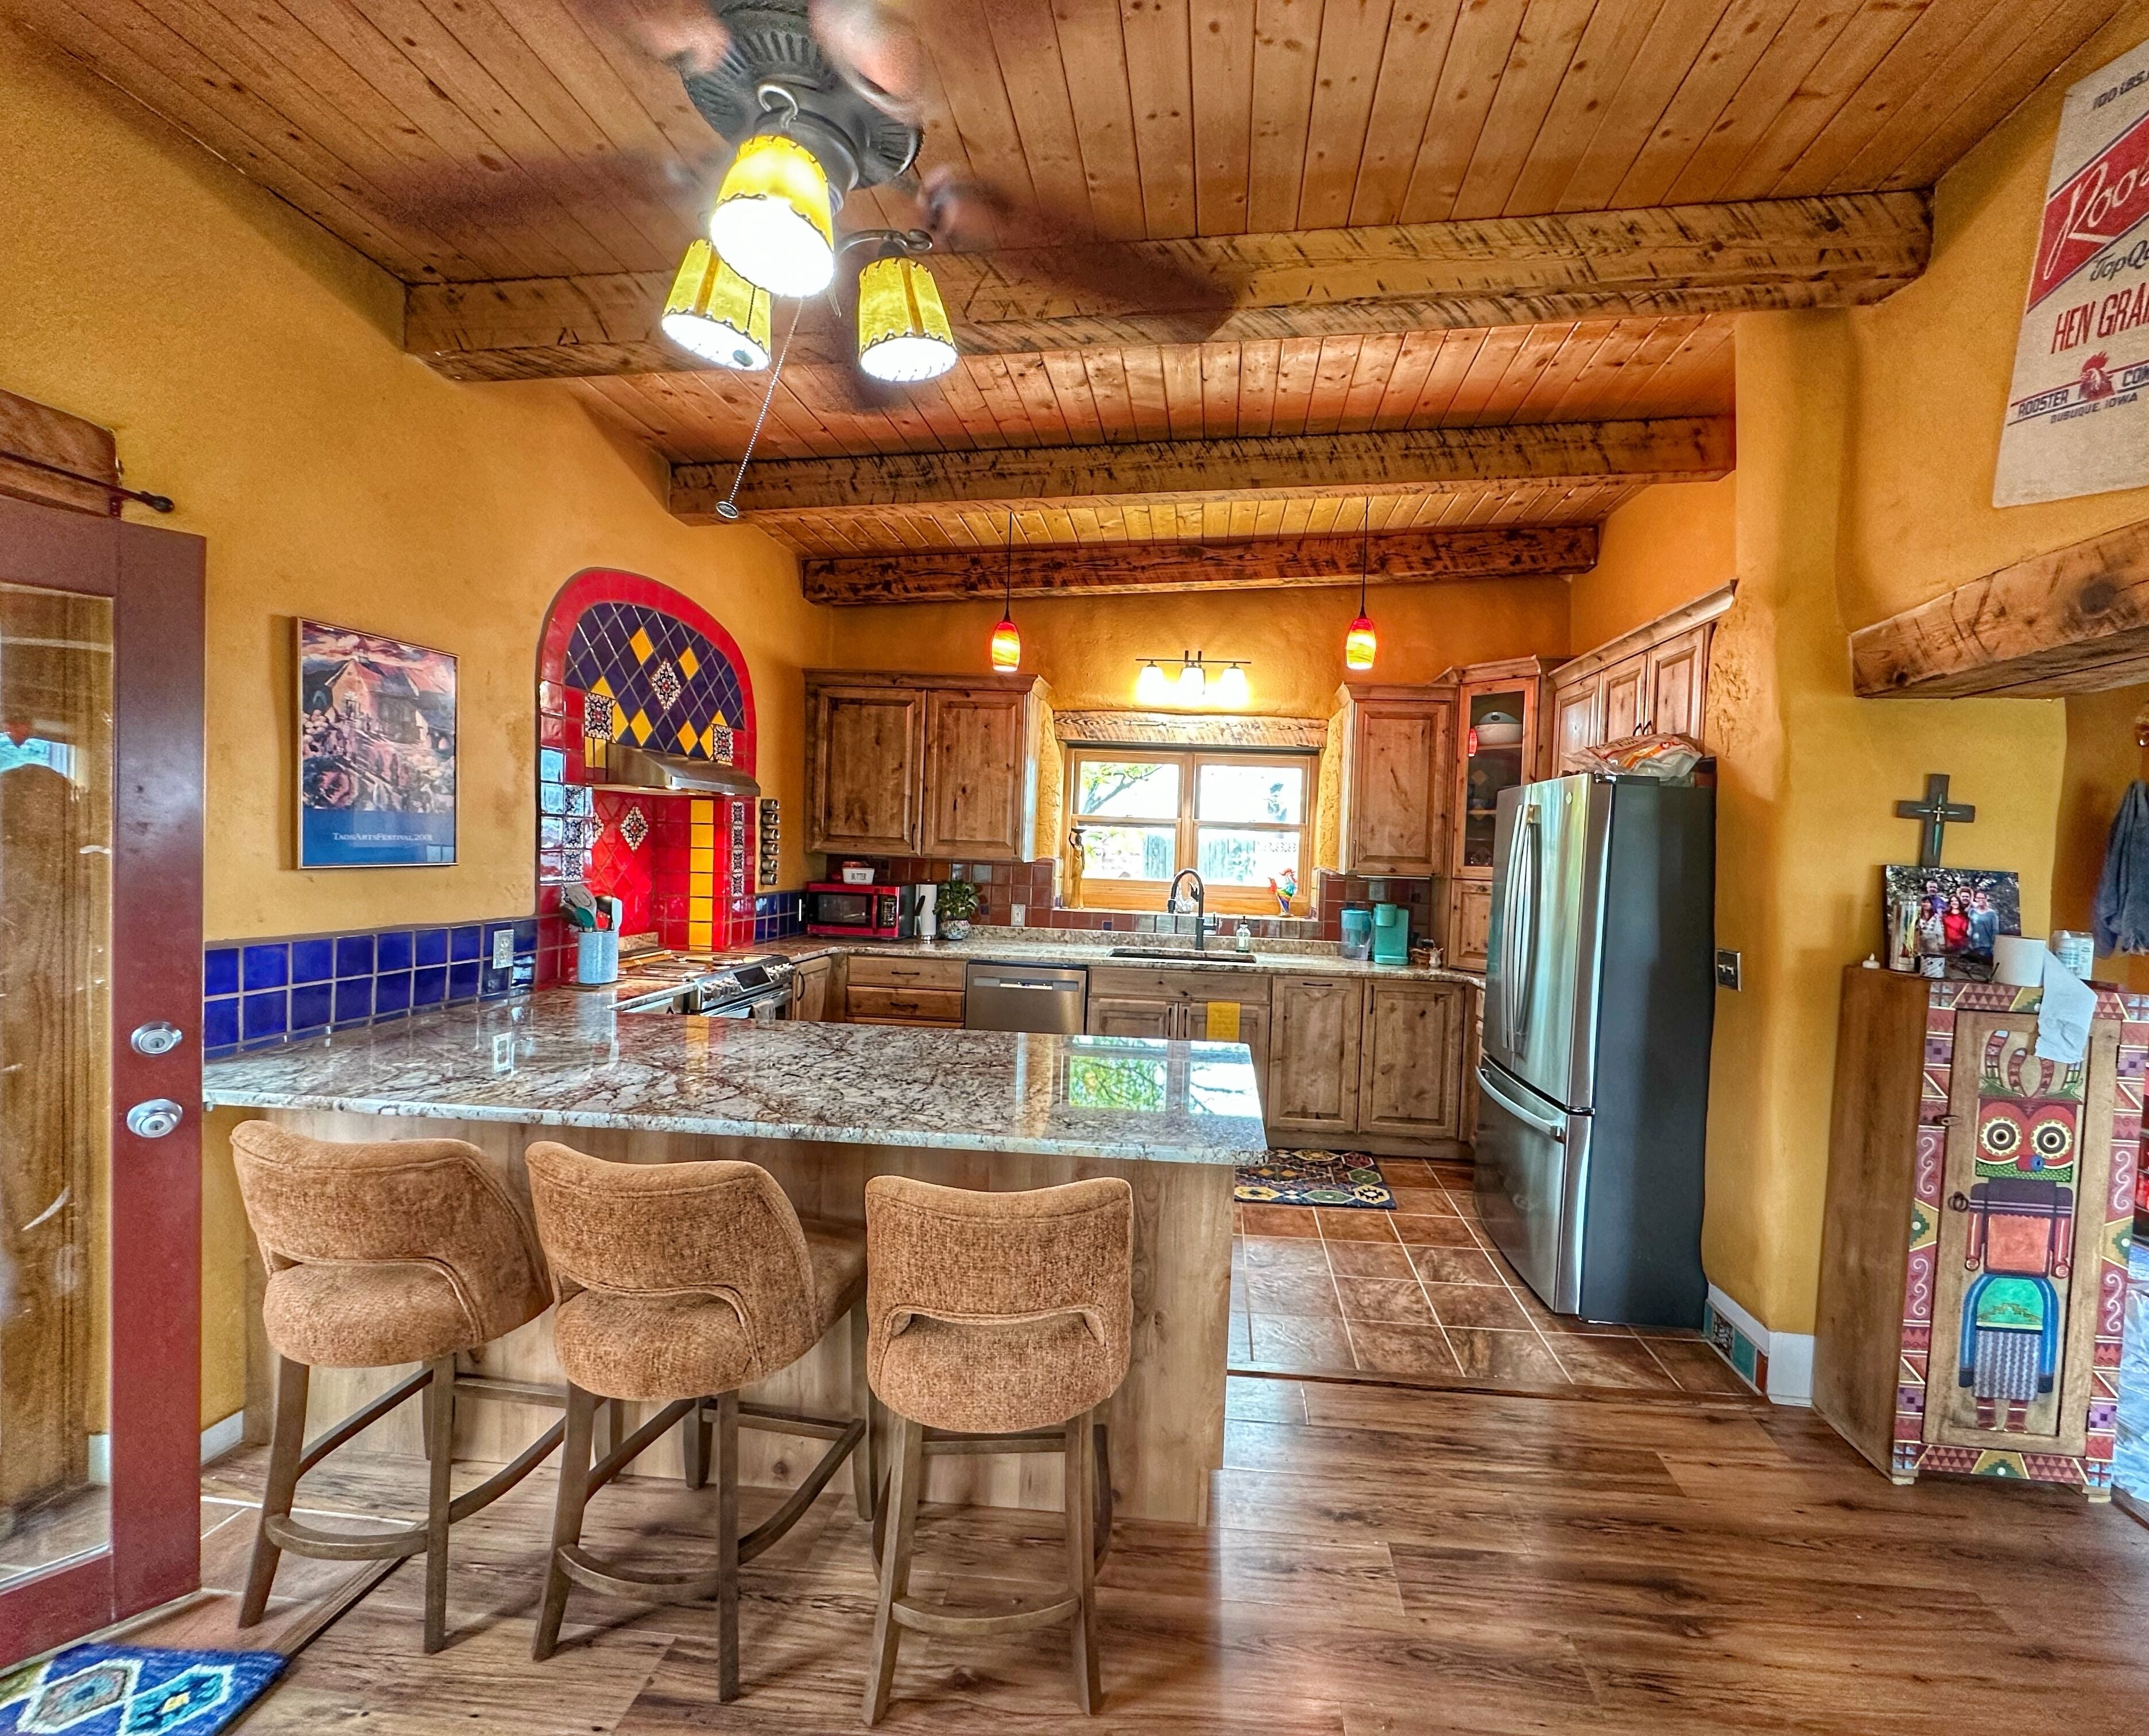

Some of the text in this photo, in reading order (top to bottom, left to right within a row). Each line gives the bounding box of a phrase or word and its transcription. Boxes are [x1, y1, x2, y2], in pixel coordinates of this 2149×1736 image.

[2051, 282, 2149, 354] HEN GRAI
[2018, 389, 2069, 418] ROOSTER
[2105, 393, 2138, 408] IOWA
